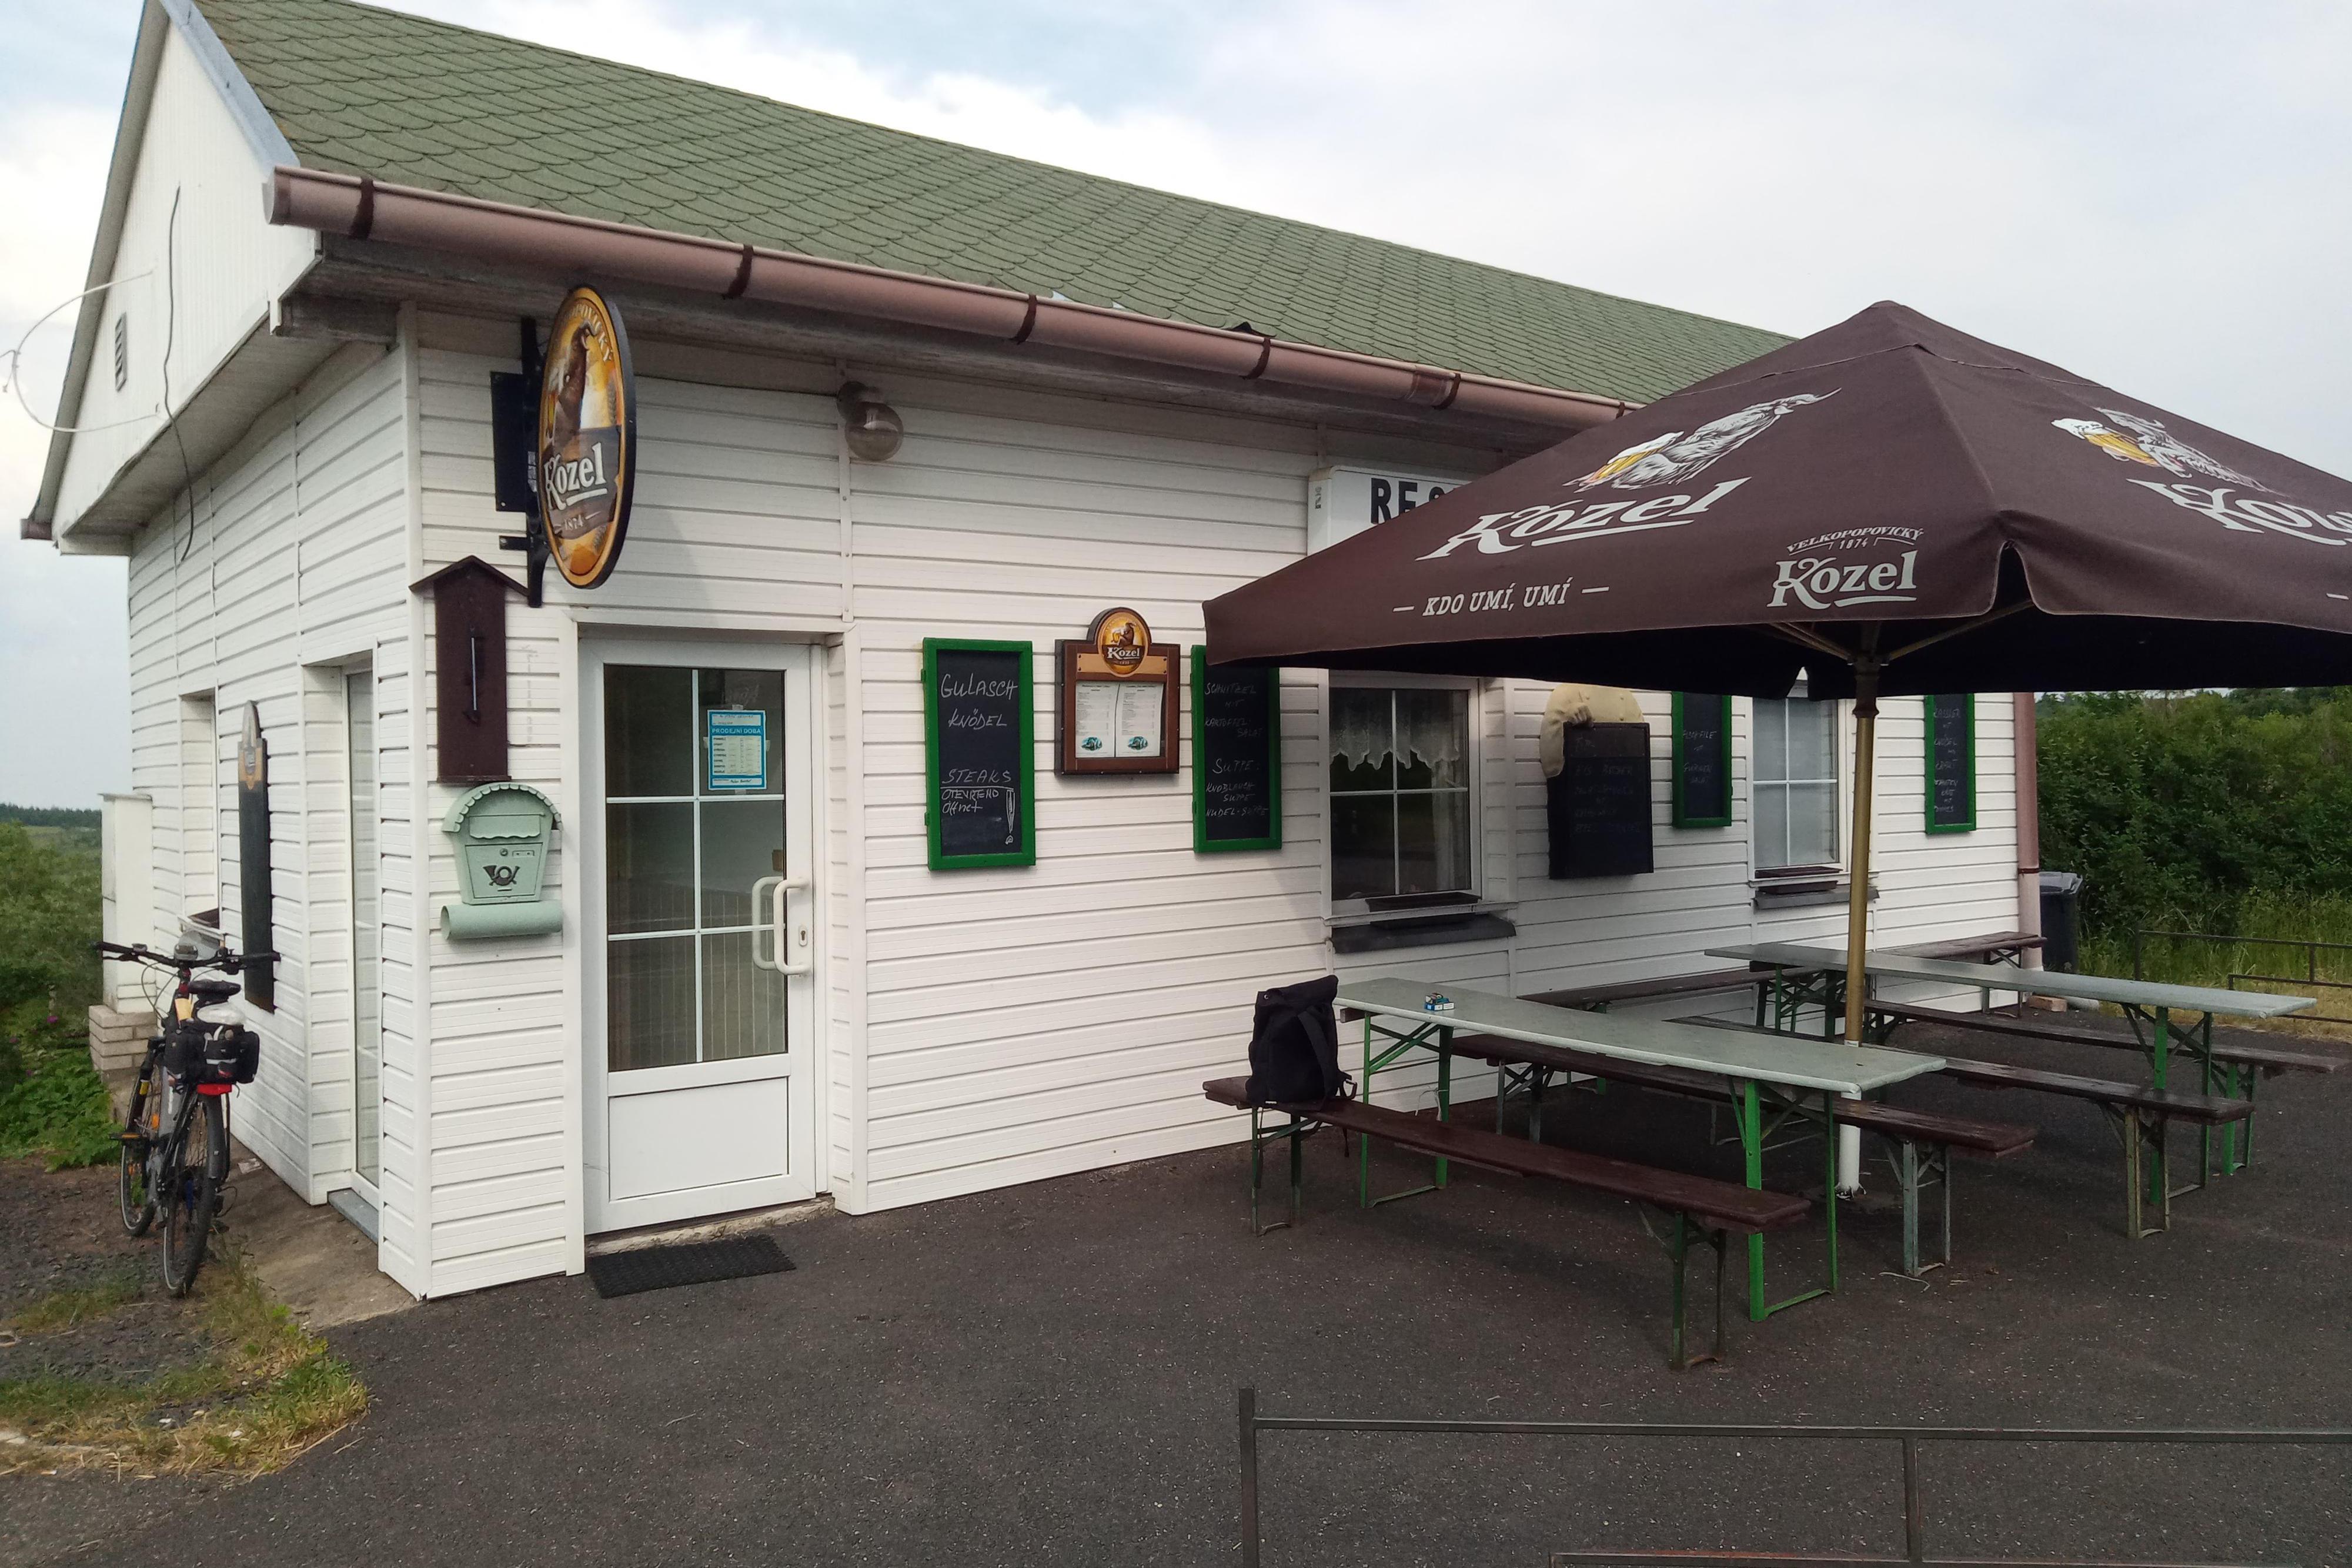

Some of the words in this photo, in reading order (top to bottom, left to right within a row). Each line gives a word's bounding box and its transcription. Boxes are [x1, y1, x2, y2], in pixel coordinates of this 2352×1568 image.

[543, 442, 607, 510] Kozel
[1371, 477, 1446, 524] RE
[1415, 476, 1752, 562] Kozel
[1786, 526, 1925, 553] VELKOPOPOVICKÝ
[1839, 537, 1869, 550] 1874
[1766, 550, 1919, 610] Kozel
[1422, 594, 1465, 616] KDO
[1468, 583, 1516, 611] UMÍ,
[1523, 577, 1573, 607] UMÍ
[1107, 646, 1141, 661] Kozel
[941, 673, 1018, 700] GULASCH
[948, 708, 1007, 730] KNÖDEL
[941, 768, 1012, 785] STEAKS
